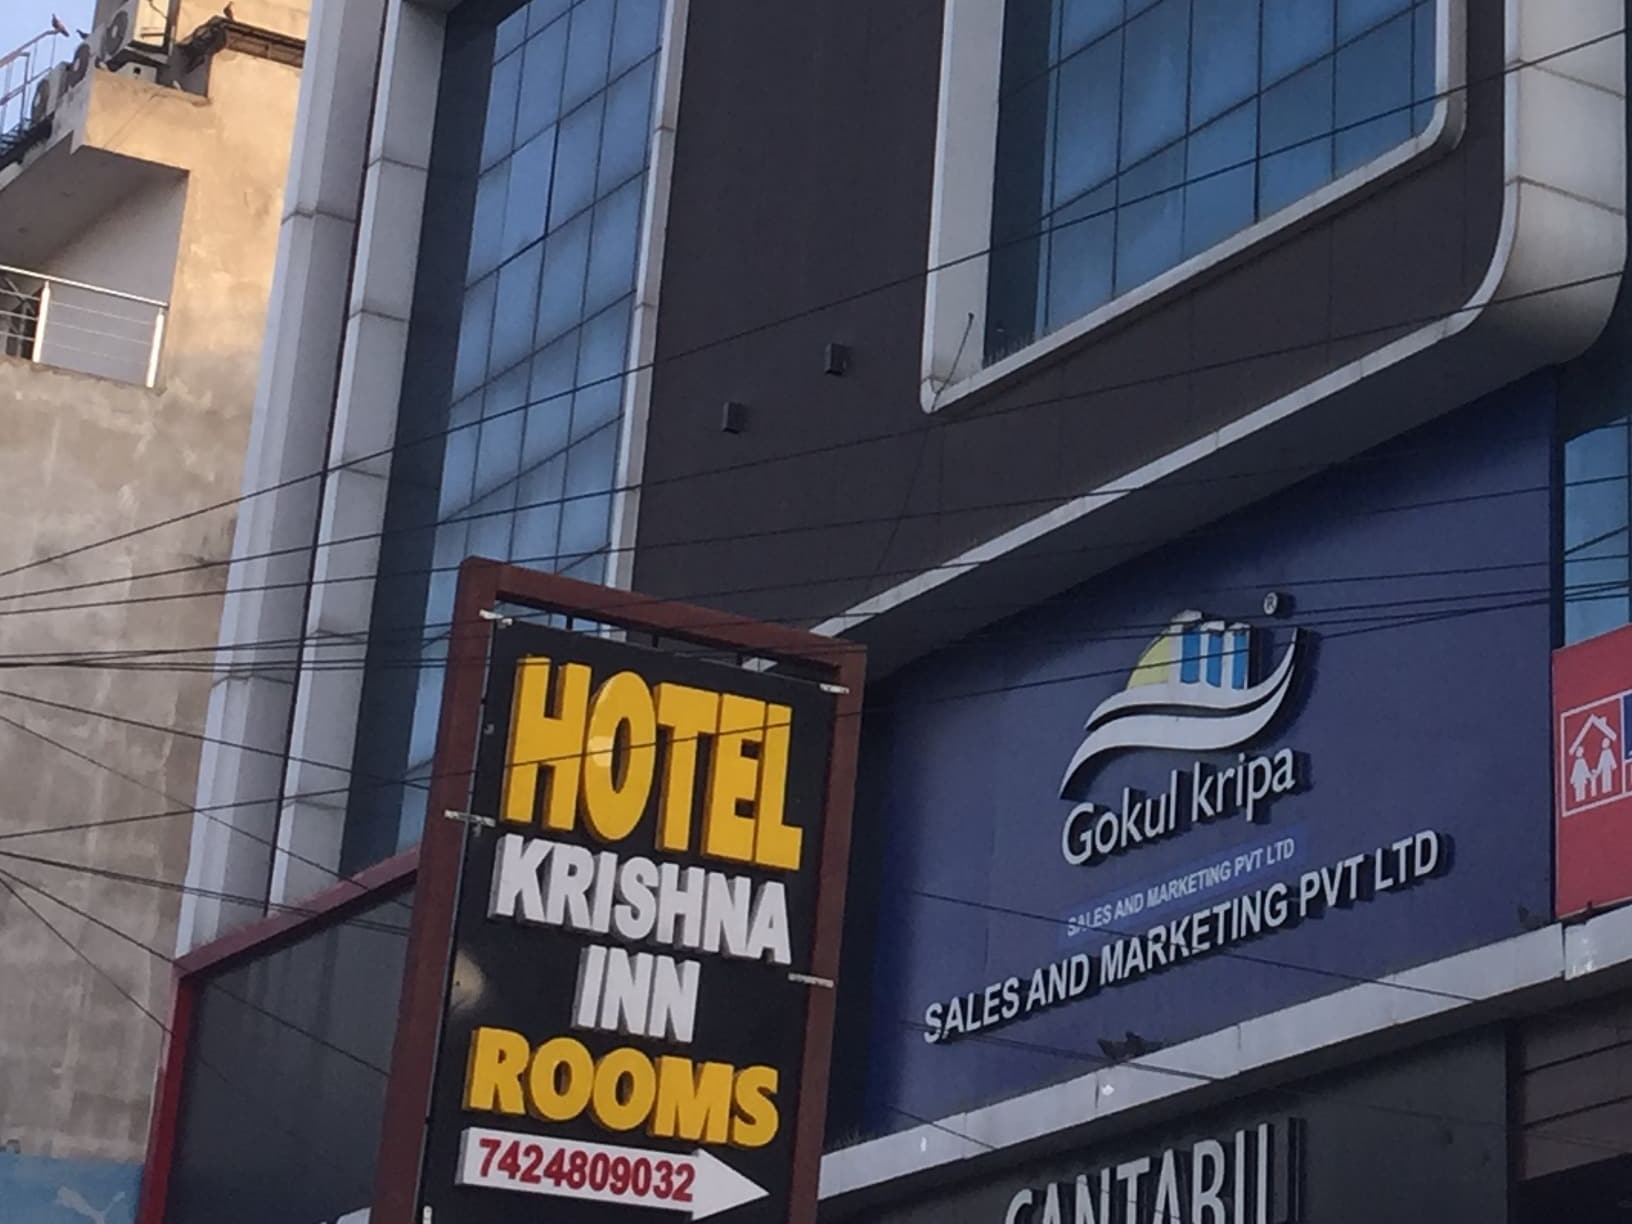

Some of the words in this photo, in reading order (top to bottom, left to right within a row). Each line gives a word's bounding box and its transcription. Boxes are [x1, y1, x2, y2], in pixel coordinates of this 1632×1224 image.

[502, 655, 803, 870] HOTEL
[1061, 769, 1178, 865] Gokul
[1191, 747, 1297, 822] kripa
[488, 833, 792, 965] KRISHNA
[923, 976, 1020, 1044] SALES
[1026, 953, 1090, 1012] AND
[1100, 882, 1289, 986] MARKETING
[1300, 853, 1365, 918] PVT
[1374, 829, 1440, 891] LTD
[1067, 904, 1112, 937] SALES
[1114, 893, 1145, 919] AND
[1146, 860, 1231, 908] MARKETING
[1234, 848, 1264, 876] PVT
[1267, 838, 1295, 864] LTD
[572, 944, 701, 1043] INN
[465, 1027, 780, 1147] ROOMS
[479, 1138, 697, 1203] 7424809032
